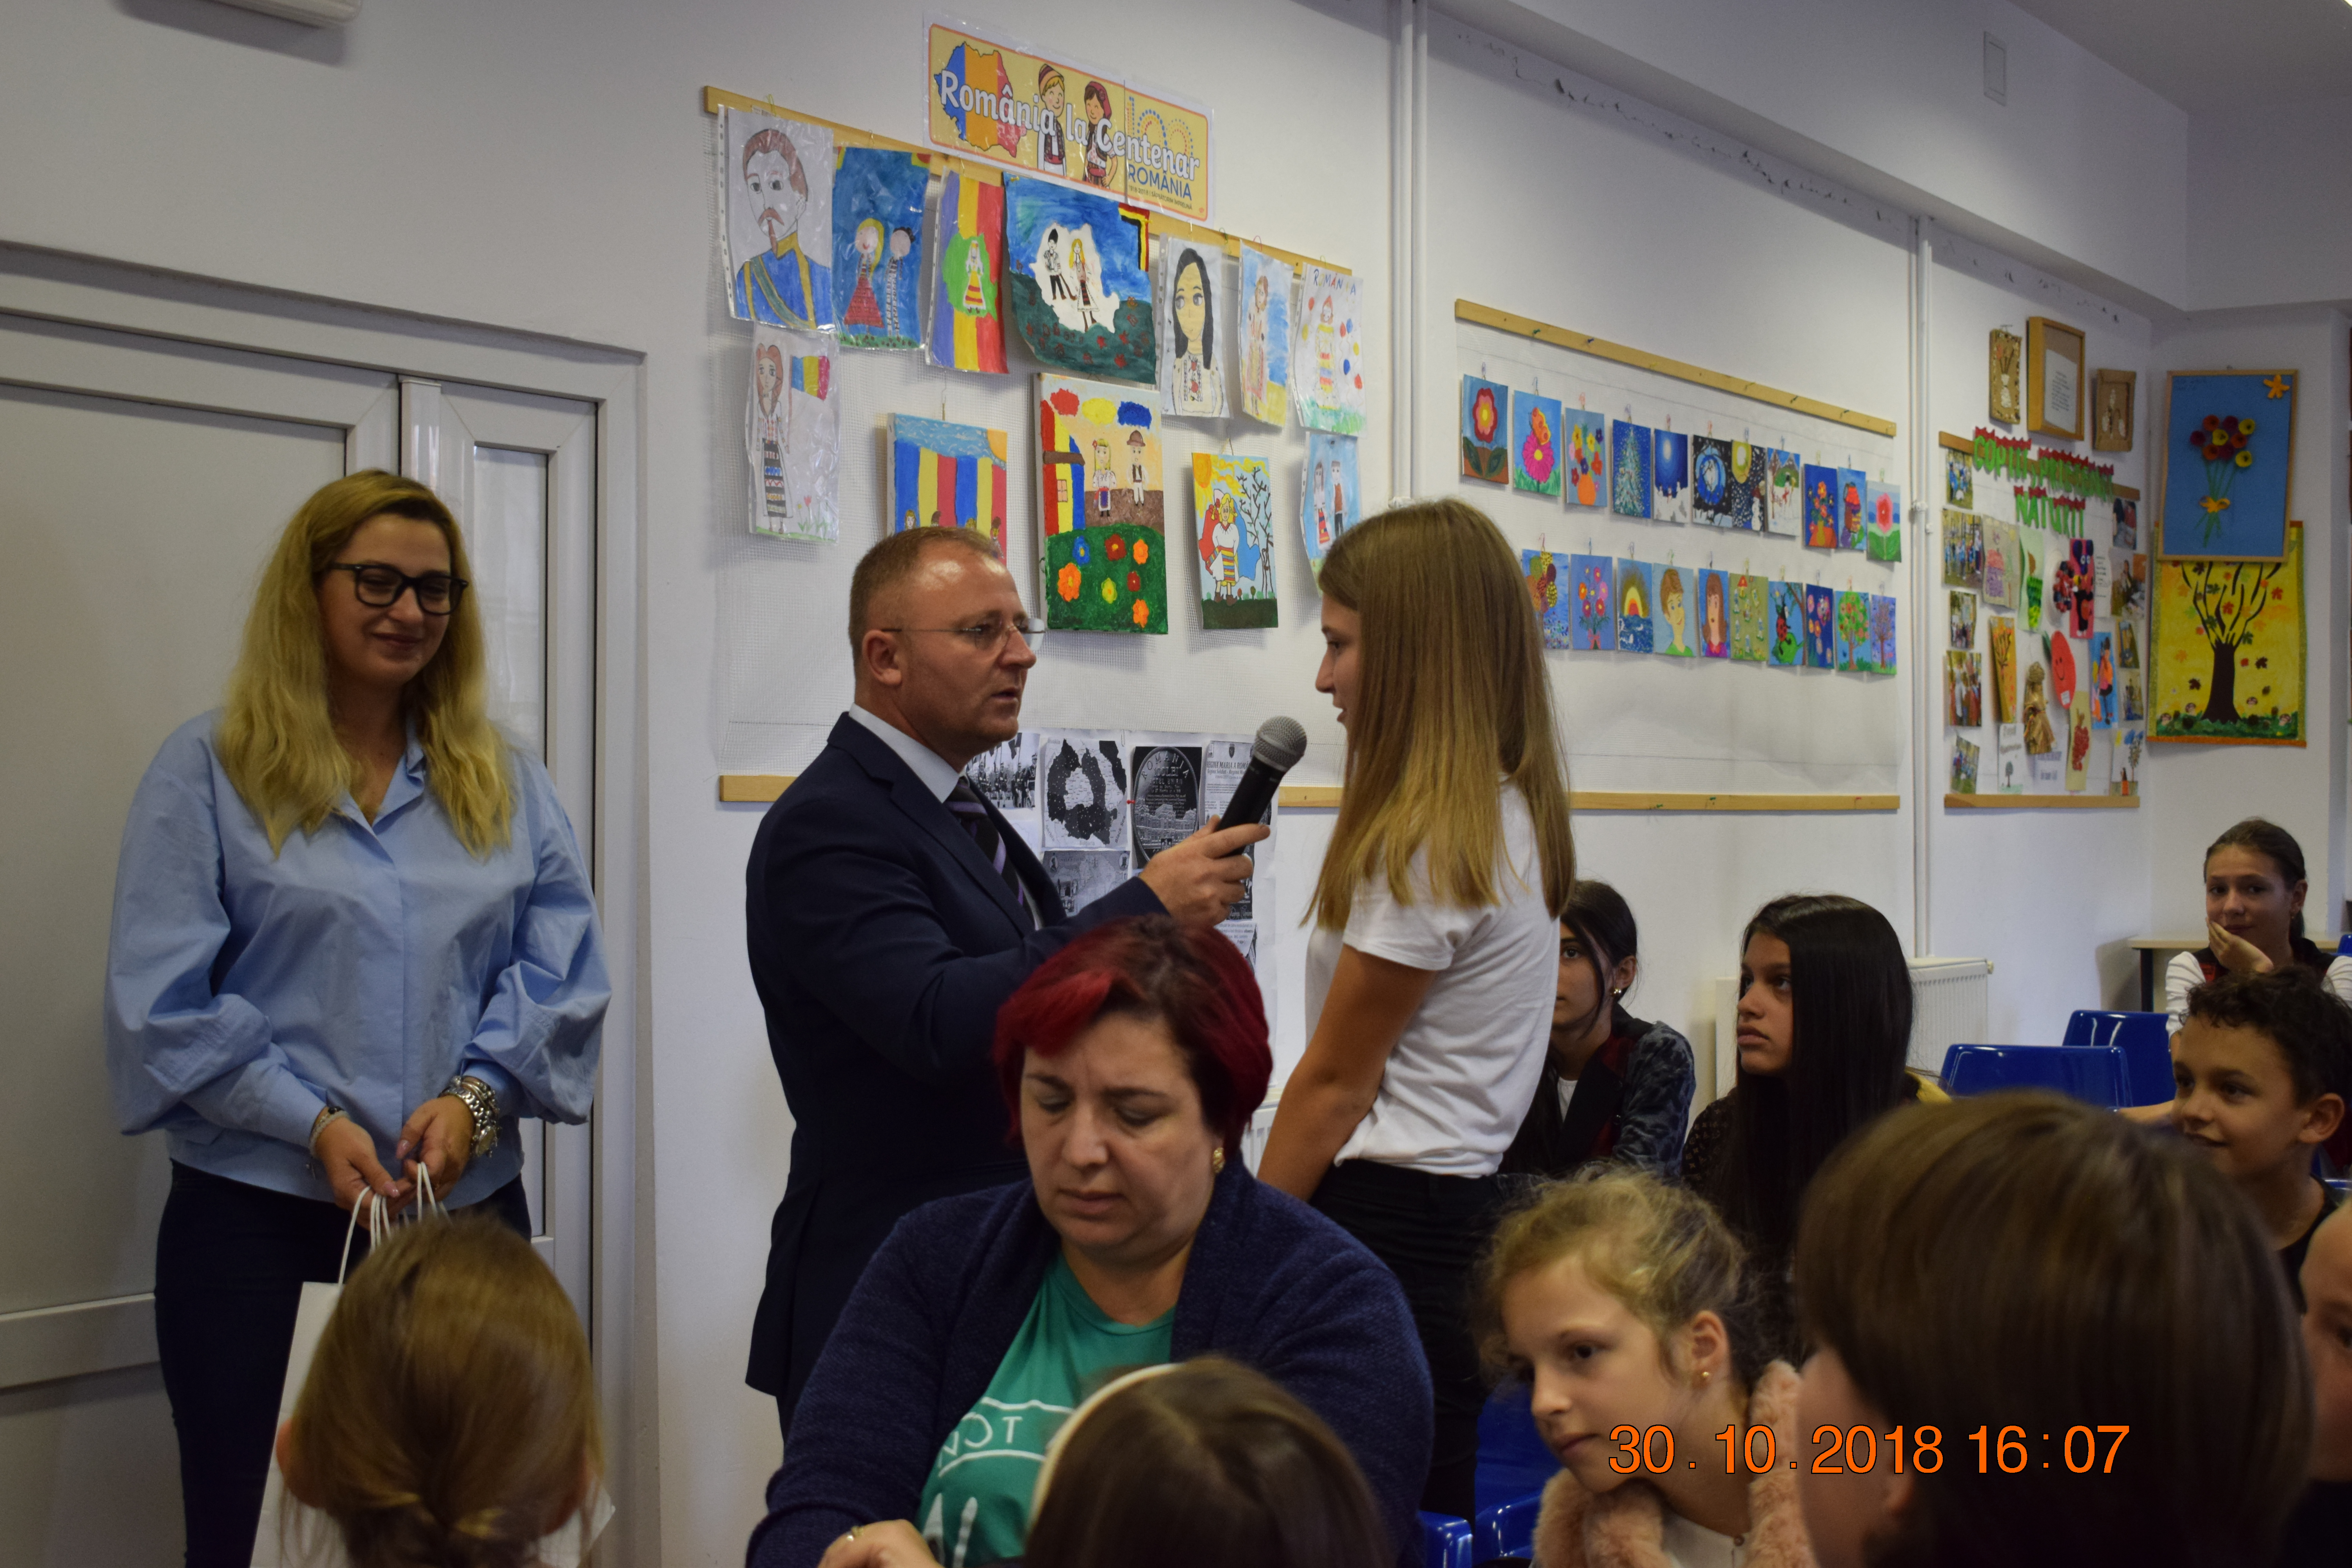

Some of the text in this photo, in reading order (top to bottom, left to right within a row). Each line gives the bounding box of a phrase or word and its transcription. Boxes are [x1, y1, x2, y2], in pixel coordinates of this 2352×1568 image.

[940, 69, 1200, 181] România la Centenar
